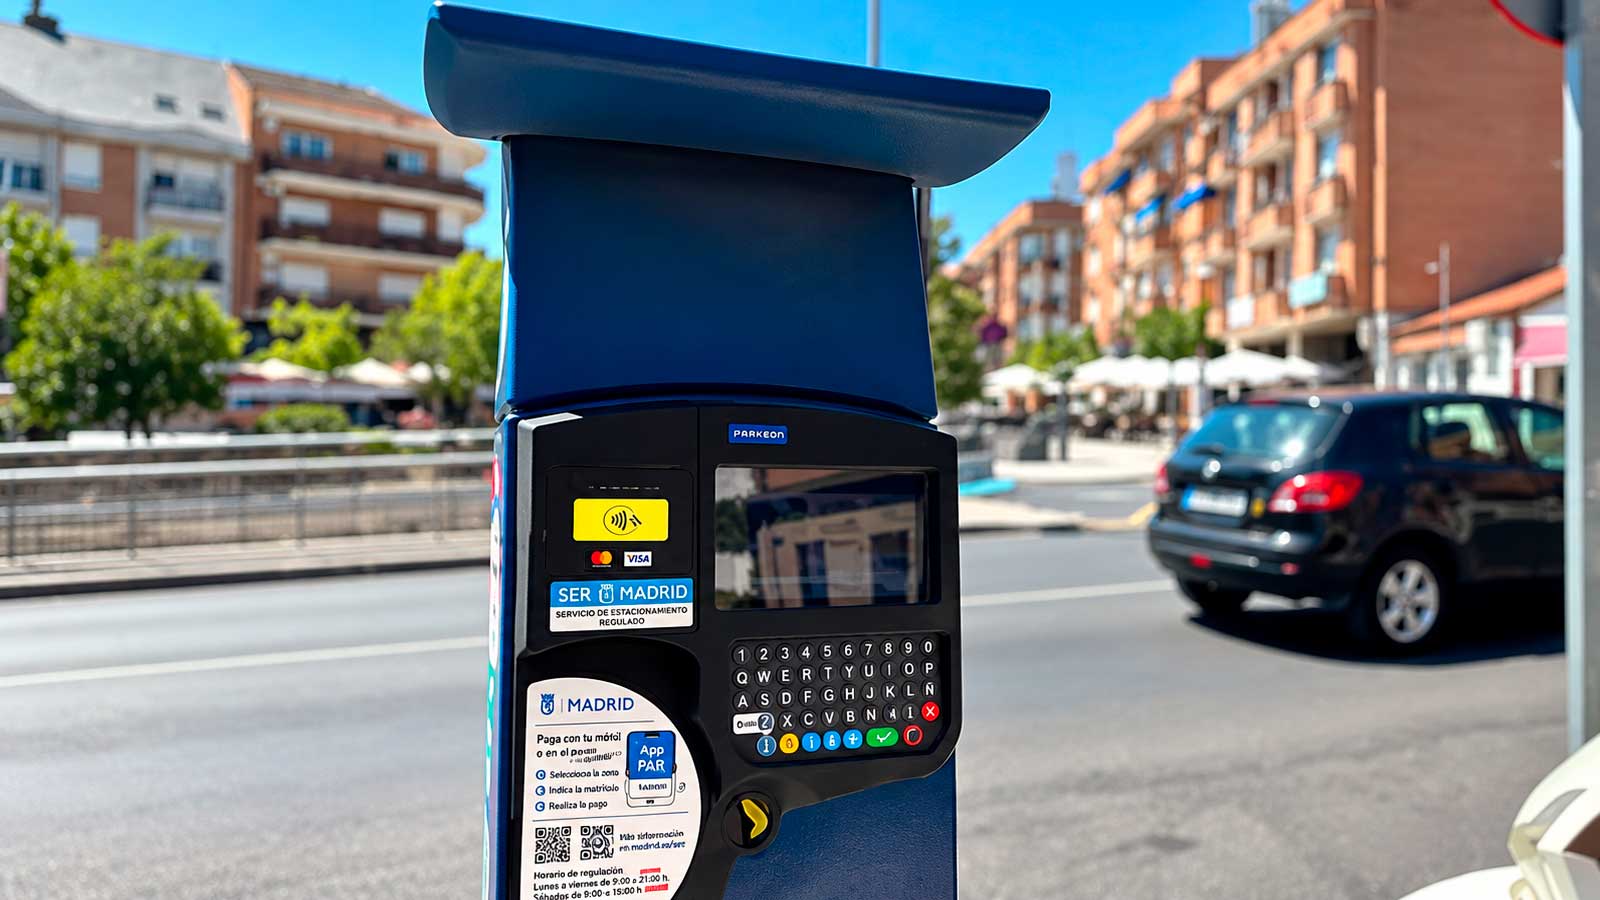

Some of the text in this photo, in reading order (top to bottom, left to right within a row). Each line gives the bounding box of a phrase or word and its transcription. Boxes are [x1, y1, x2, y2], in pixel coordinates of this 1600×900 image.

[626, 554, 650, 563] VISA
[558, 585, 688, 602] SER MADRID
[555, 609, 595, 618] SERVICIO
[611, 606, 688, 616] ESTACIONAMIENTO
[599, 618, 645, 626] REGULADO
[738, 648, 745, 662] 1
[760, 647, 768, 661] 2
[781, 646, 790, 660] 3
[801, 646, 811, 659] 4
[823, 644, 832, 658] 5
[844, 644, 853, 657] 6
[864, 643, 873, 656] 7
[884, 642, 893, 655] 8
[904, 641, 913, 654] 9
[736, 662, 934, 685] Q W E R T Y U I O P
[737, 681, 934, 708] A S D F G H J K L Ñ
[567, 697, 635, 712] MADRID
[782, 714, 793, 728] X
[803, 712, 814, 726] C
[824, 711, 835, 724] V
[846, 710, 855, 723] B
[866, 708, 876, 721] N
[536, 734, 561, 745] Paga
[563, 735, 580, 744] con
[583, 733, 593, 742] tu
[536, 750, 543, 758] o
[545, 750, 558, 758] en
[639, 745, 665, 758] App
[637, 759, 666, 773] PAR
[533, 870, 566, 880] Horario
[638, 874, 661, 884] 21:00
